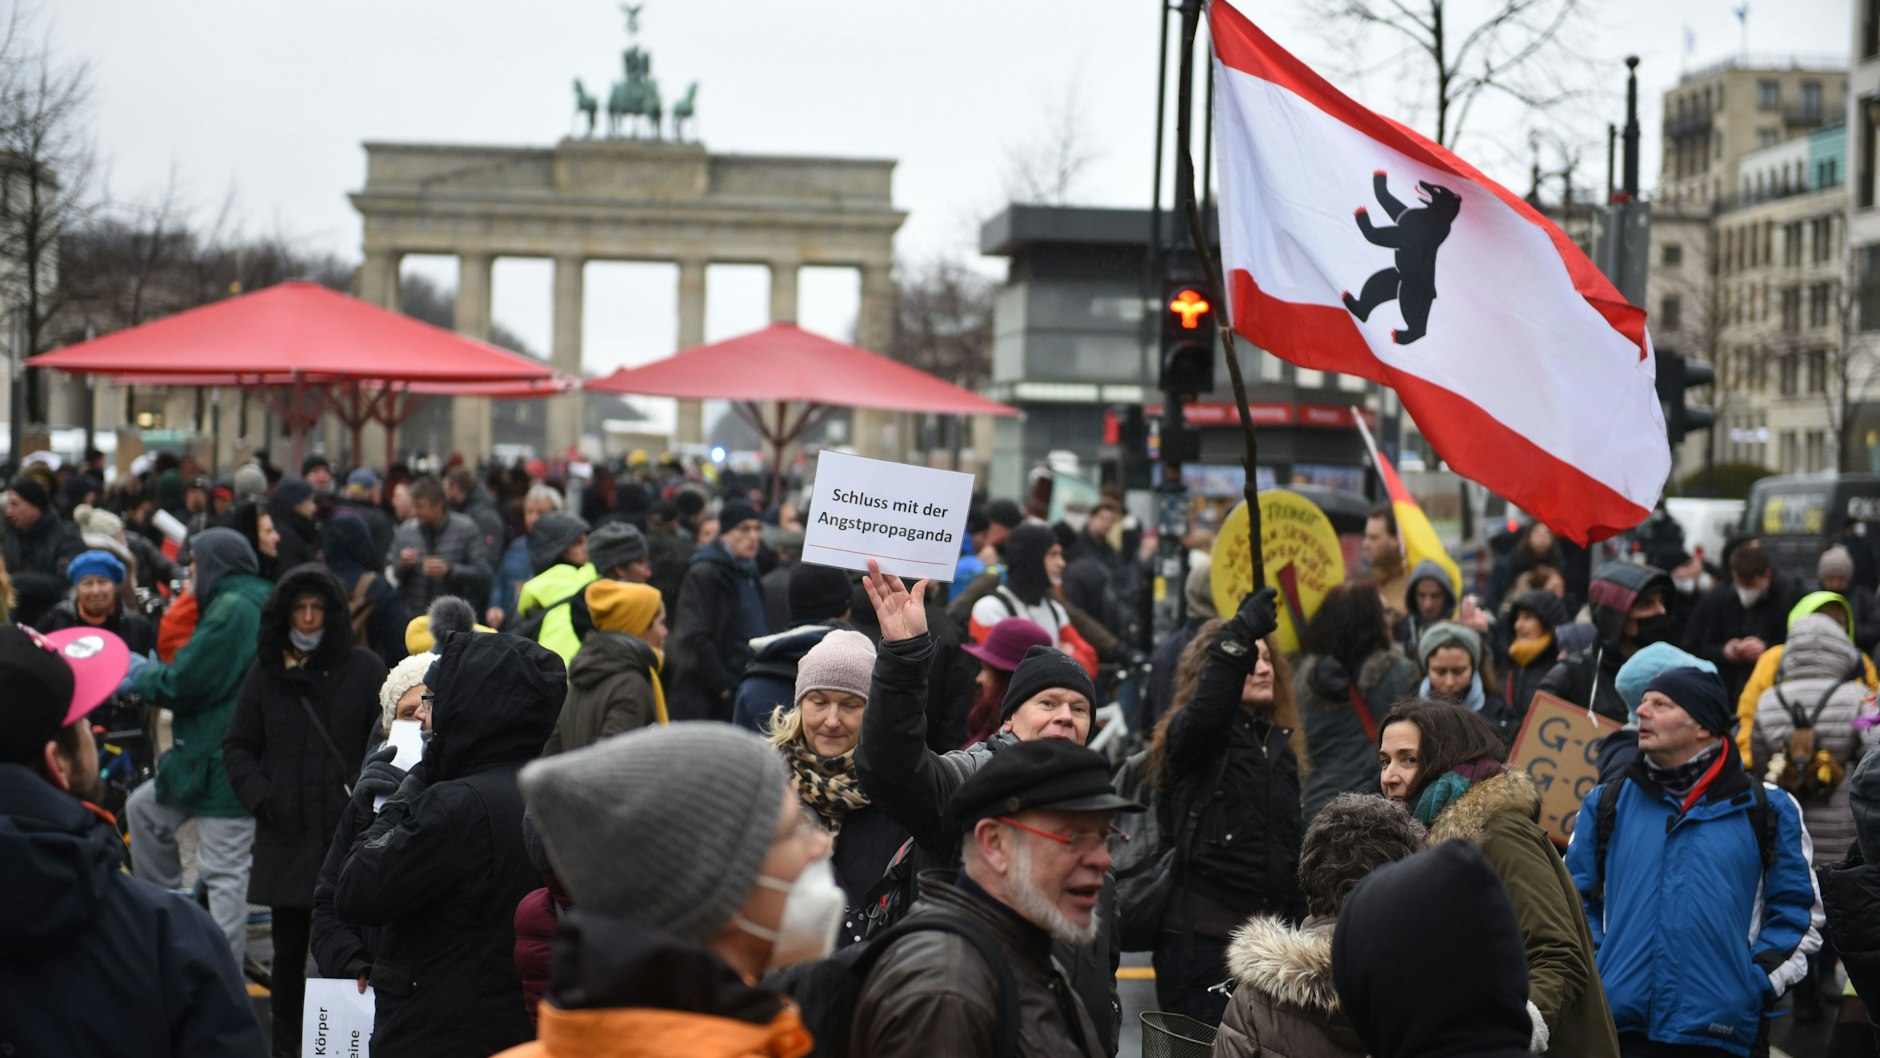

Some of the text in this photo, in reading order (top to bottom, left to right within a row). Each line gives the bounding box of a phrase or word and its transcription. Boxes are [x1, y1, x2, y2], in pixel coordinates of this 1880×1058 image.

[832, 488, 948, 518] Schluss mit der
[817, 511, 953, 543] Angstpropaganda
[315, 1007, 329, 1055] Körper
